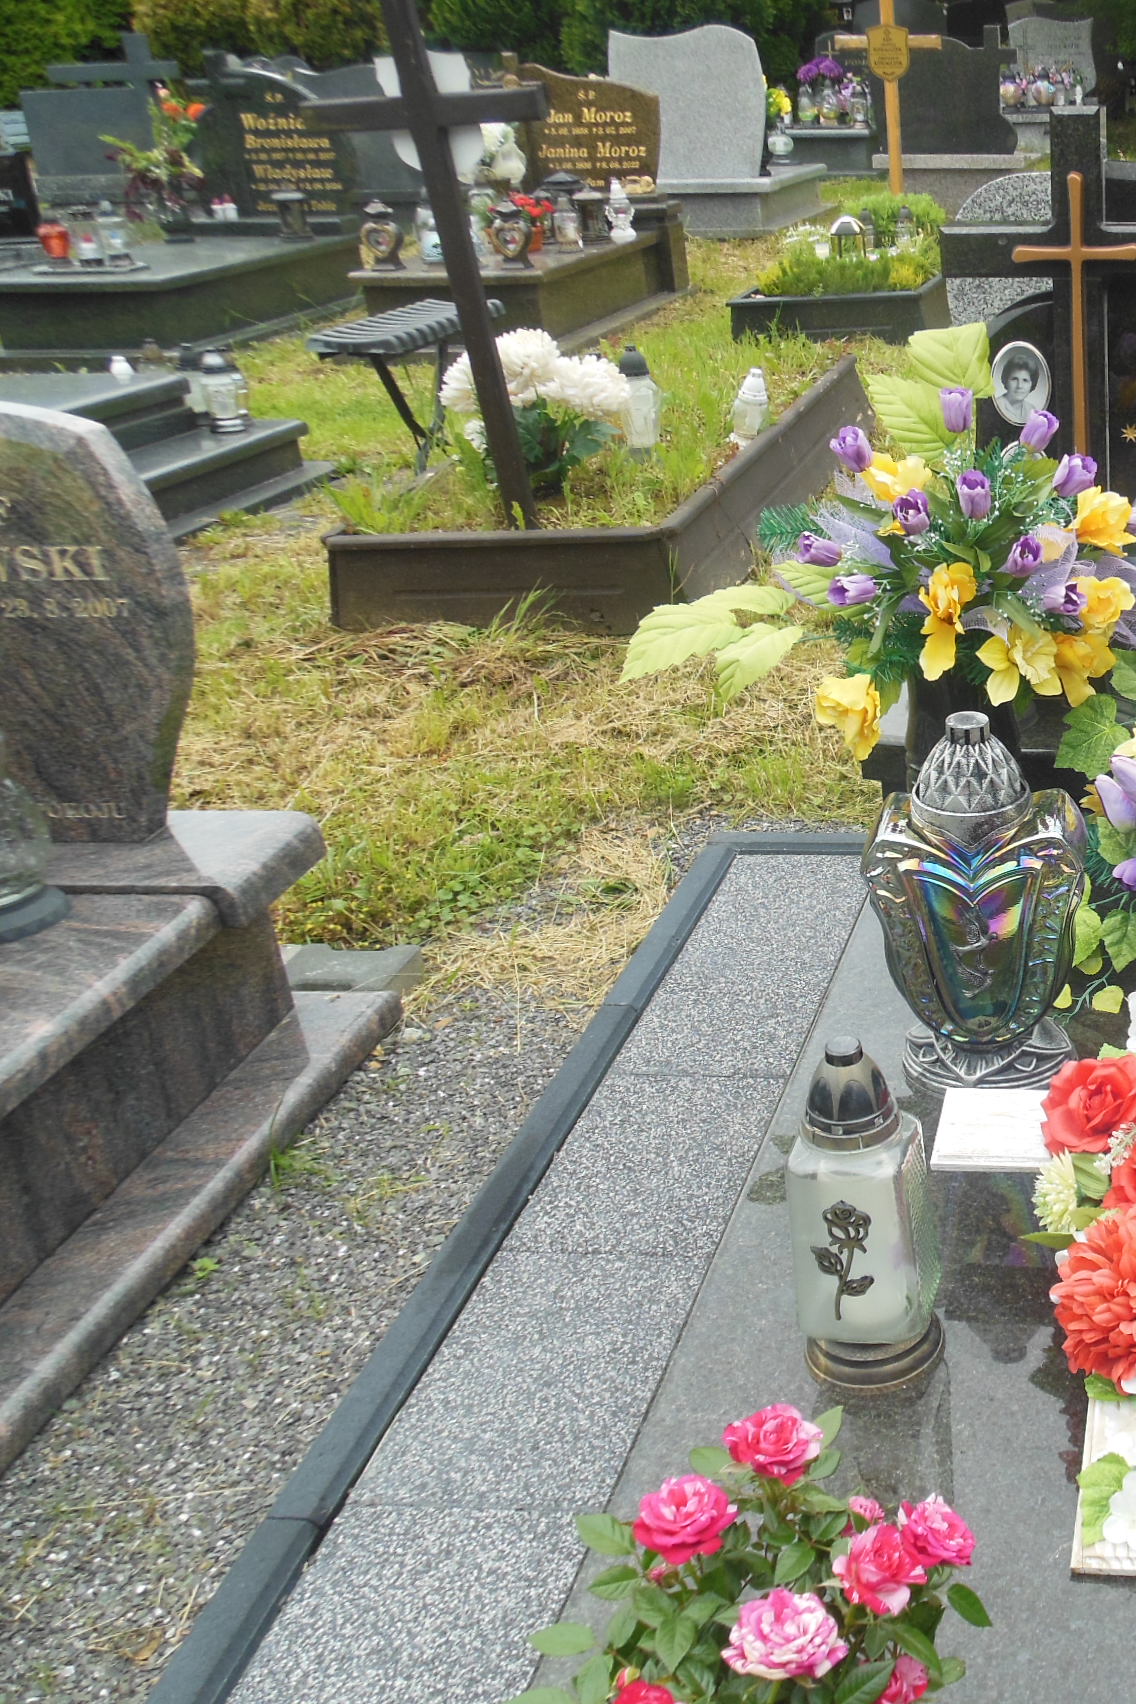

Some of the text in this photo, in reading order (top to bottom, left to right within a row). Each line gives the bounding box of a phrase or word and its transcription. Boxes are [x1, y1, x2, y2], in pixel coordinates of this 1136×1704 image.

[545, 106, 634, 124] Jan Moroz
[538, 142, 648, 158] Janina Moroz
